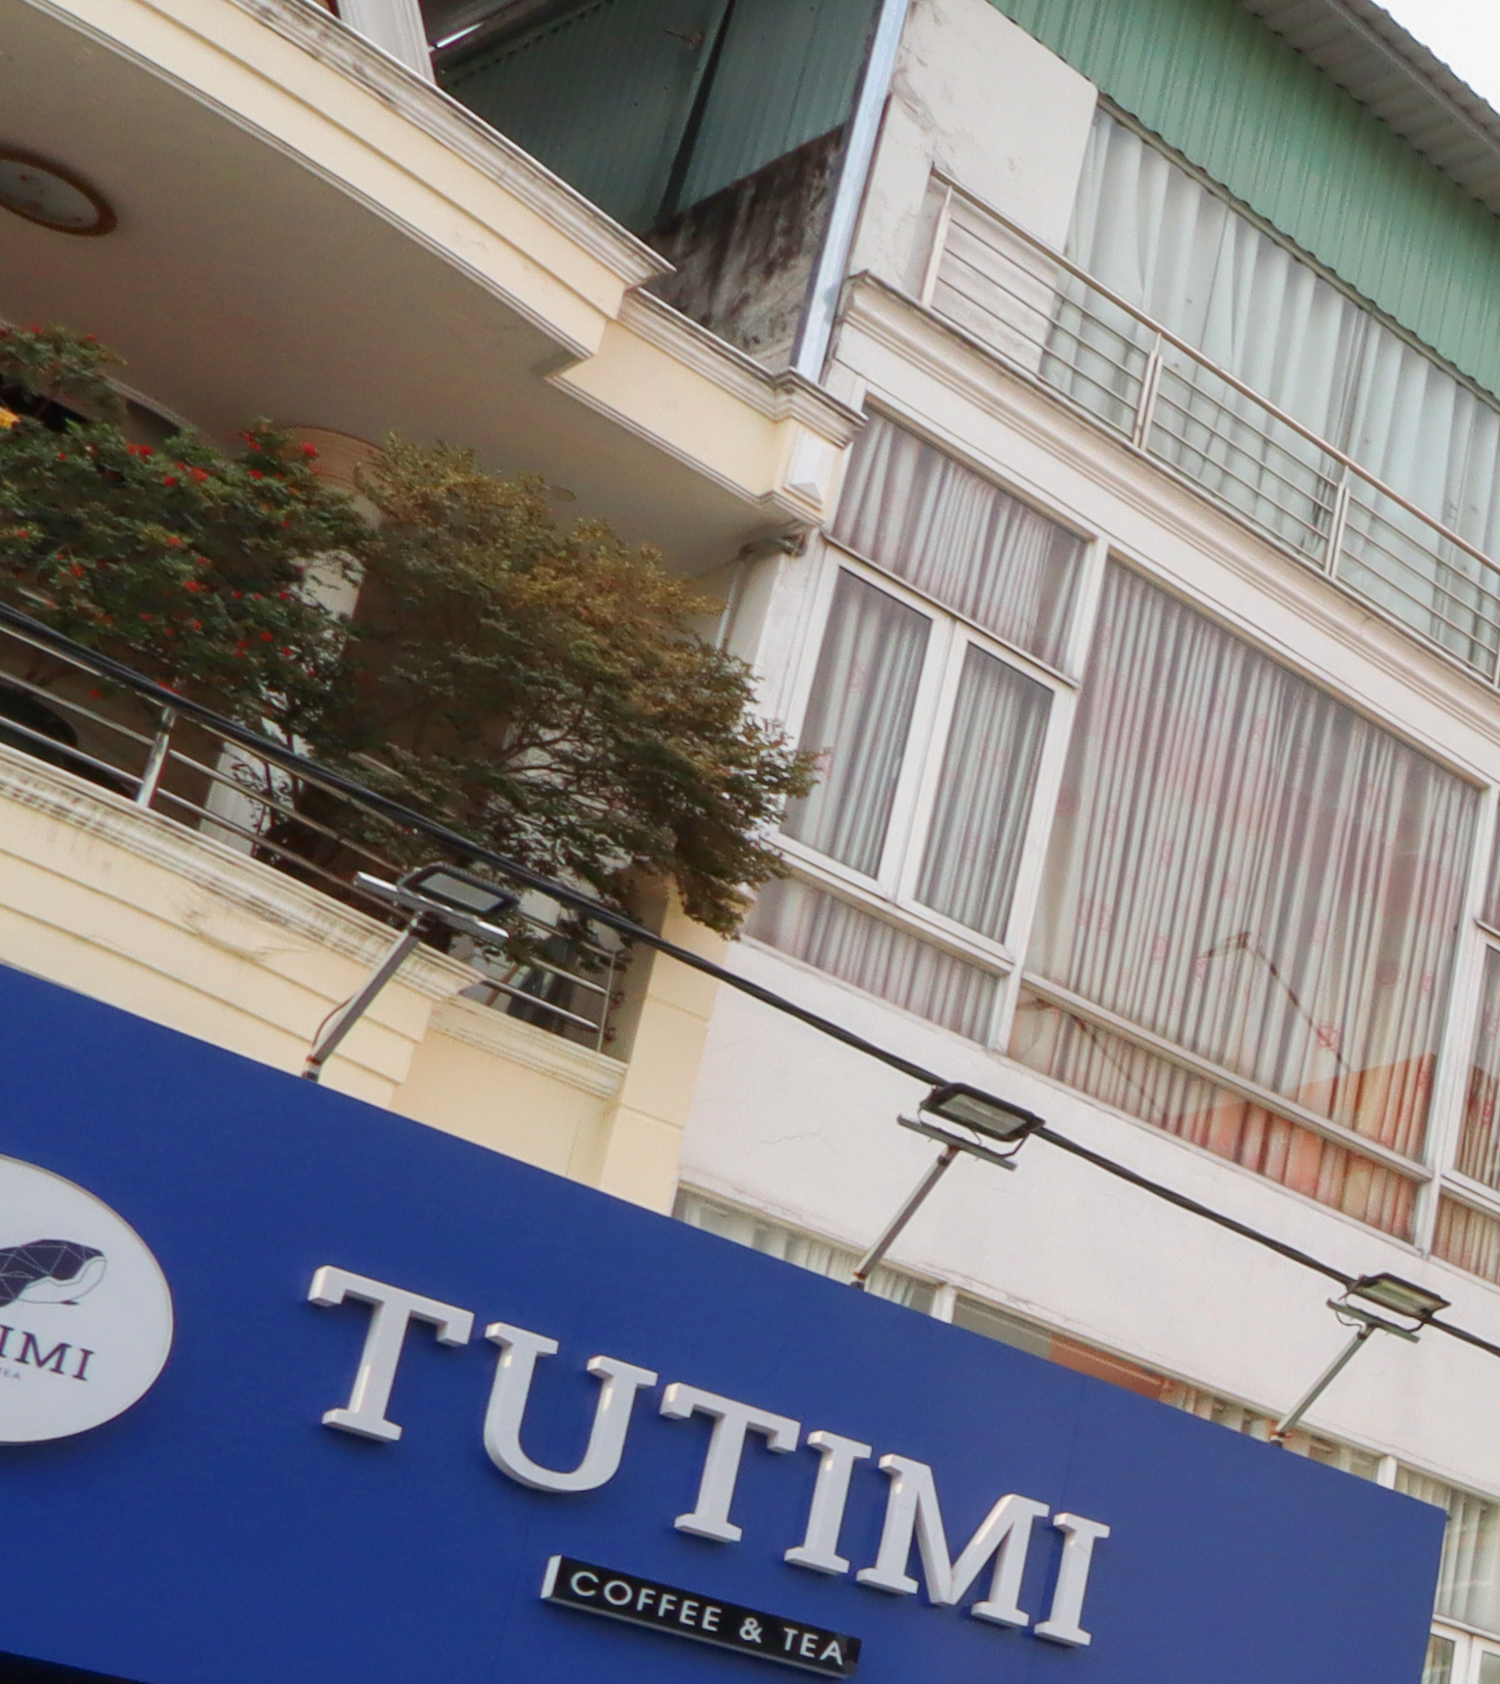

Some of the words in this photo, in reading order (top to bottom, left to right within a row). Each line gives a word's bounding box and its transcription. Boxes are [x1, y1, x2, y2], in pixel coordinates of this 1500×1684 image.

[307, 1264, 1110, 1648] TUTIMI
[570, 1571, 722, 1632] COFFEE
[739, 1617, 762, 1643] &
[784, 1627, 843, 1666] TEA
